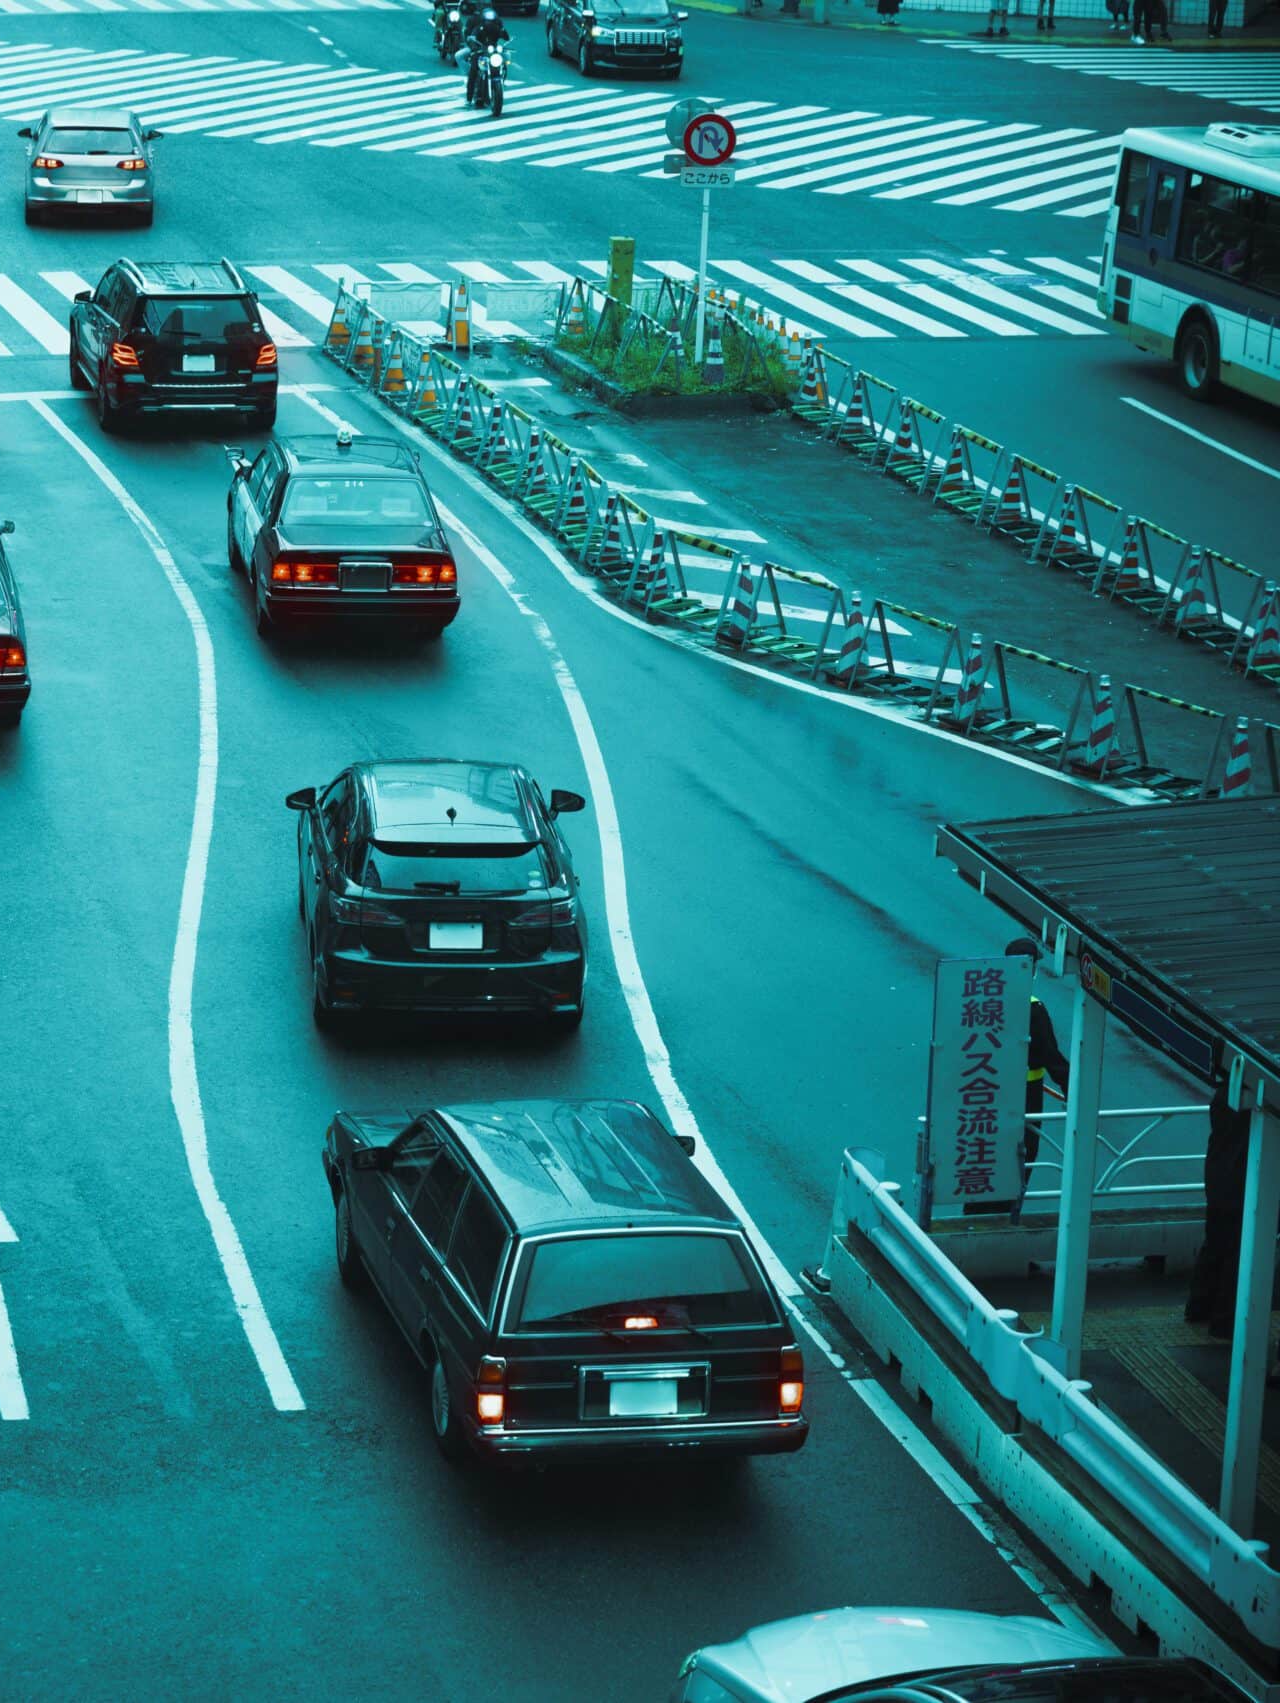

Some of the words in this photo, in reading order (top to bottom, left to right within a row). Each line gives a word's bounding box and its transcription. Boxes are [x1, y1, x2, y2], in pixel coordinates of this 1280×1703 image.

[684, 172, 731, 185] ここから
[953, 969, 1008, 1196] 路線バス合流注意
